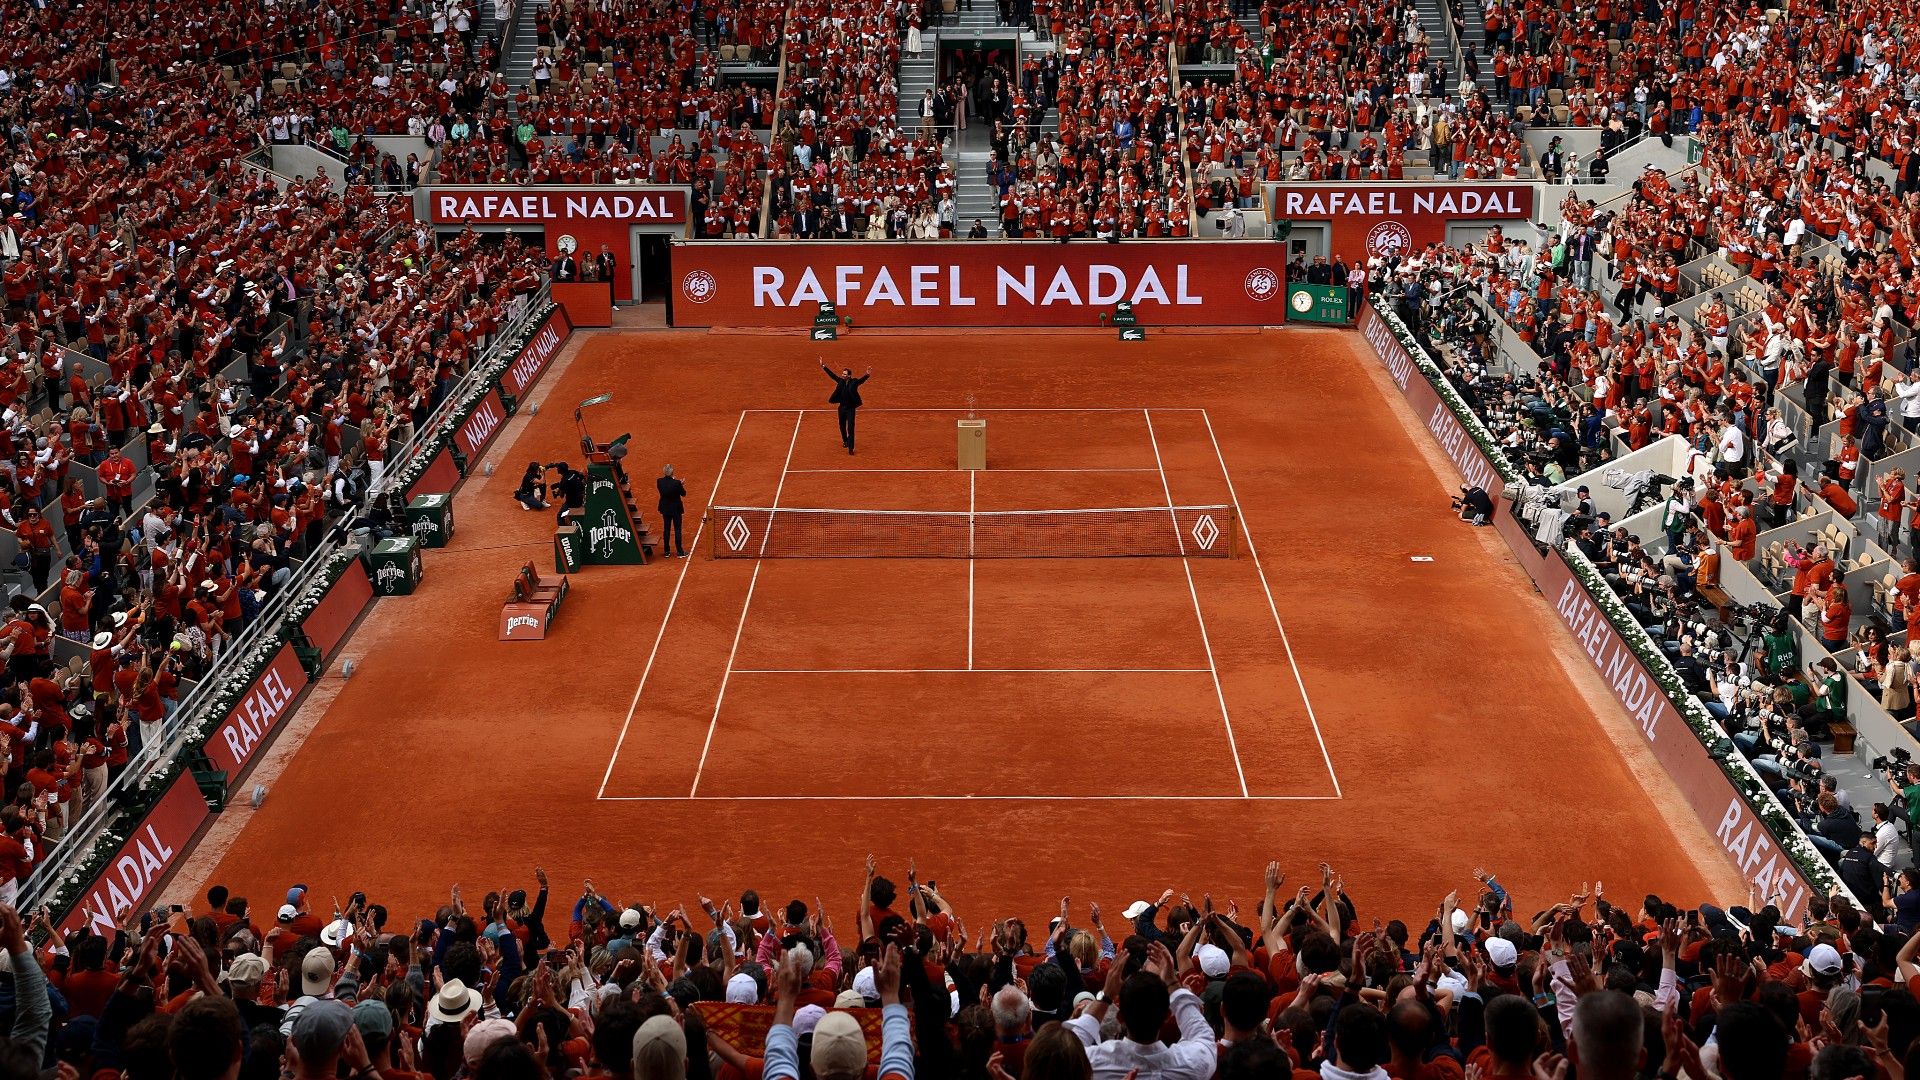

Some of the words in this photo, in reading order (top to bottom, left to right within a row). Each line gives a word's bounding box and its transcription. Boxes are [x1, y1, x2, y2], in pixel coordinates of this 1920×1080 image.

[440, 196, 557, 218] RAFAEL
[566, 196, 674, 218] NADAL
[1286, 192, 1403, 215] RAFAEL
[1413, 191, 1521, 214] NADAL
[752, 264, 976, 307] RAFAEL
[996, 264, 1203, 306] NADAL
[1320, 296, 1344, 305] ROLEX
[512, 346, 541, 390] RAFAEL
[535, 323, 560, 362] NADAL
[1364, 313, 1392, 362] RAFAEL
[1384, 342, 1413, 391] NADAL
[463, 401, 499, 452] NADAL
[1428, 402, 1465, 463] RAFAEL
[561, 536, 575, 567] Wilson
[1556, 578, 1612, 669] RAFAEL
[1604, 643, 1666, 742] NADAL
[222, 667, 293, 765] RAFAEL
[81, 823, 174, 937] NADAL
